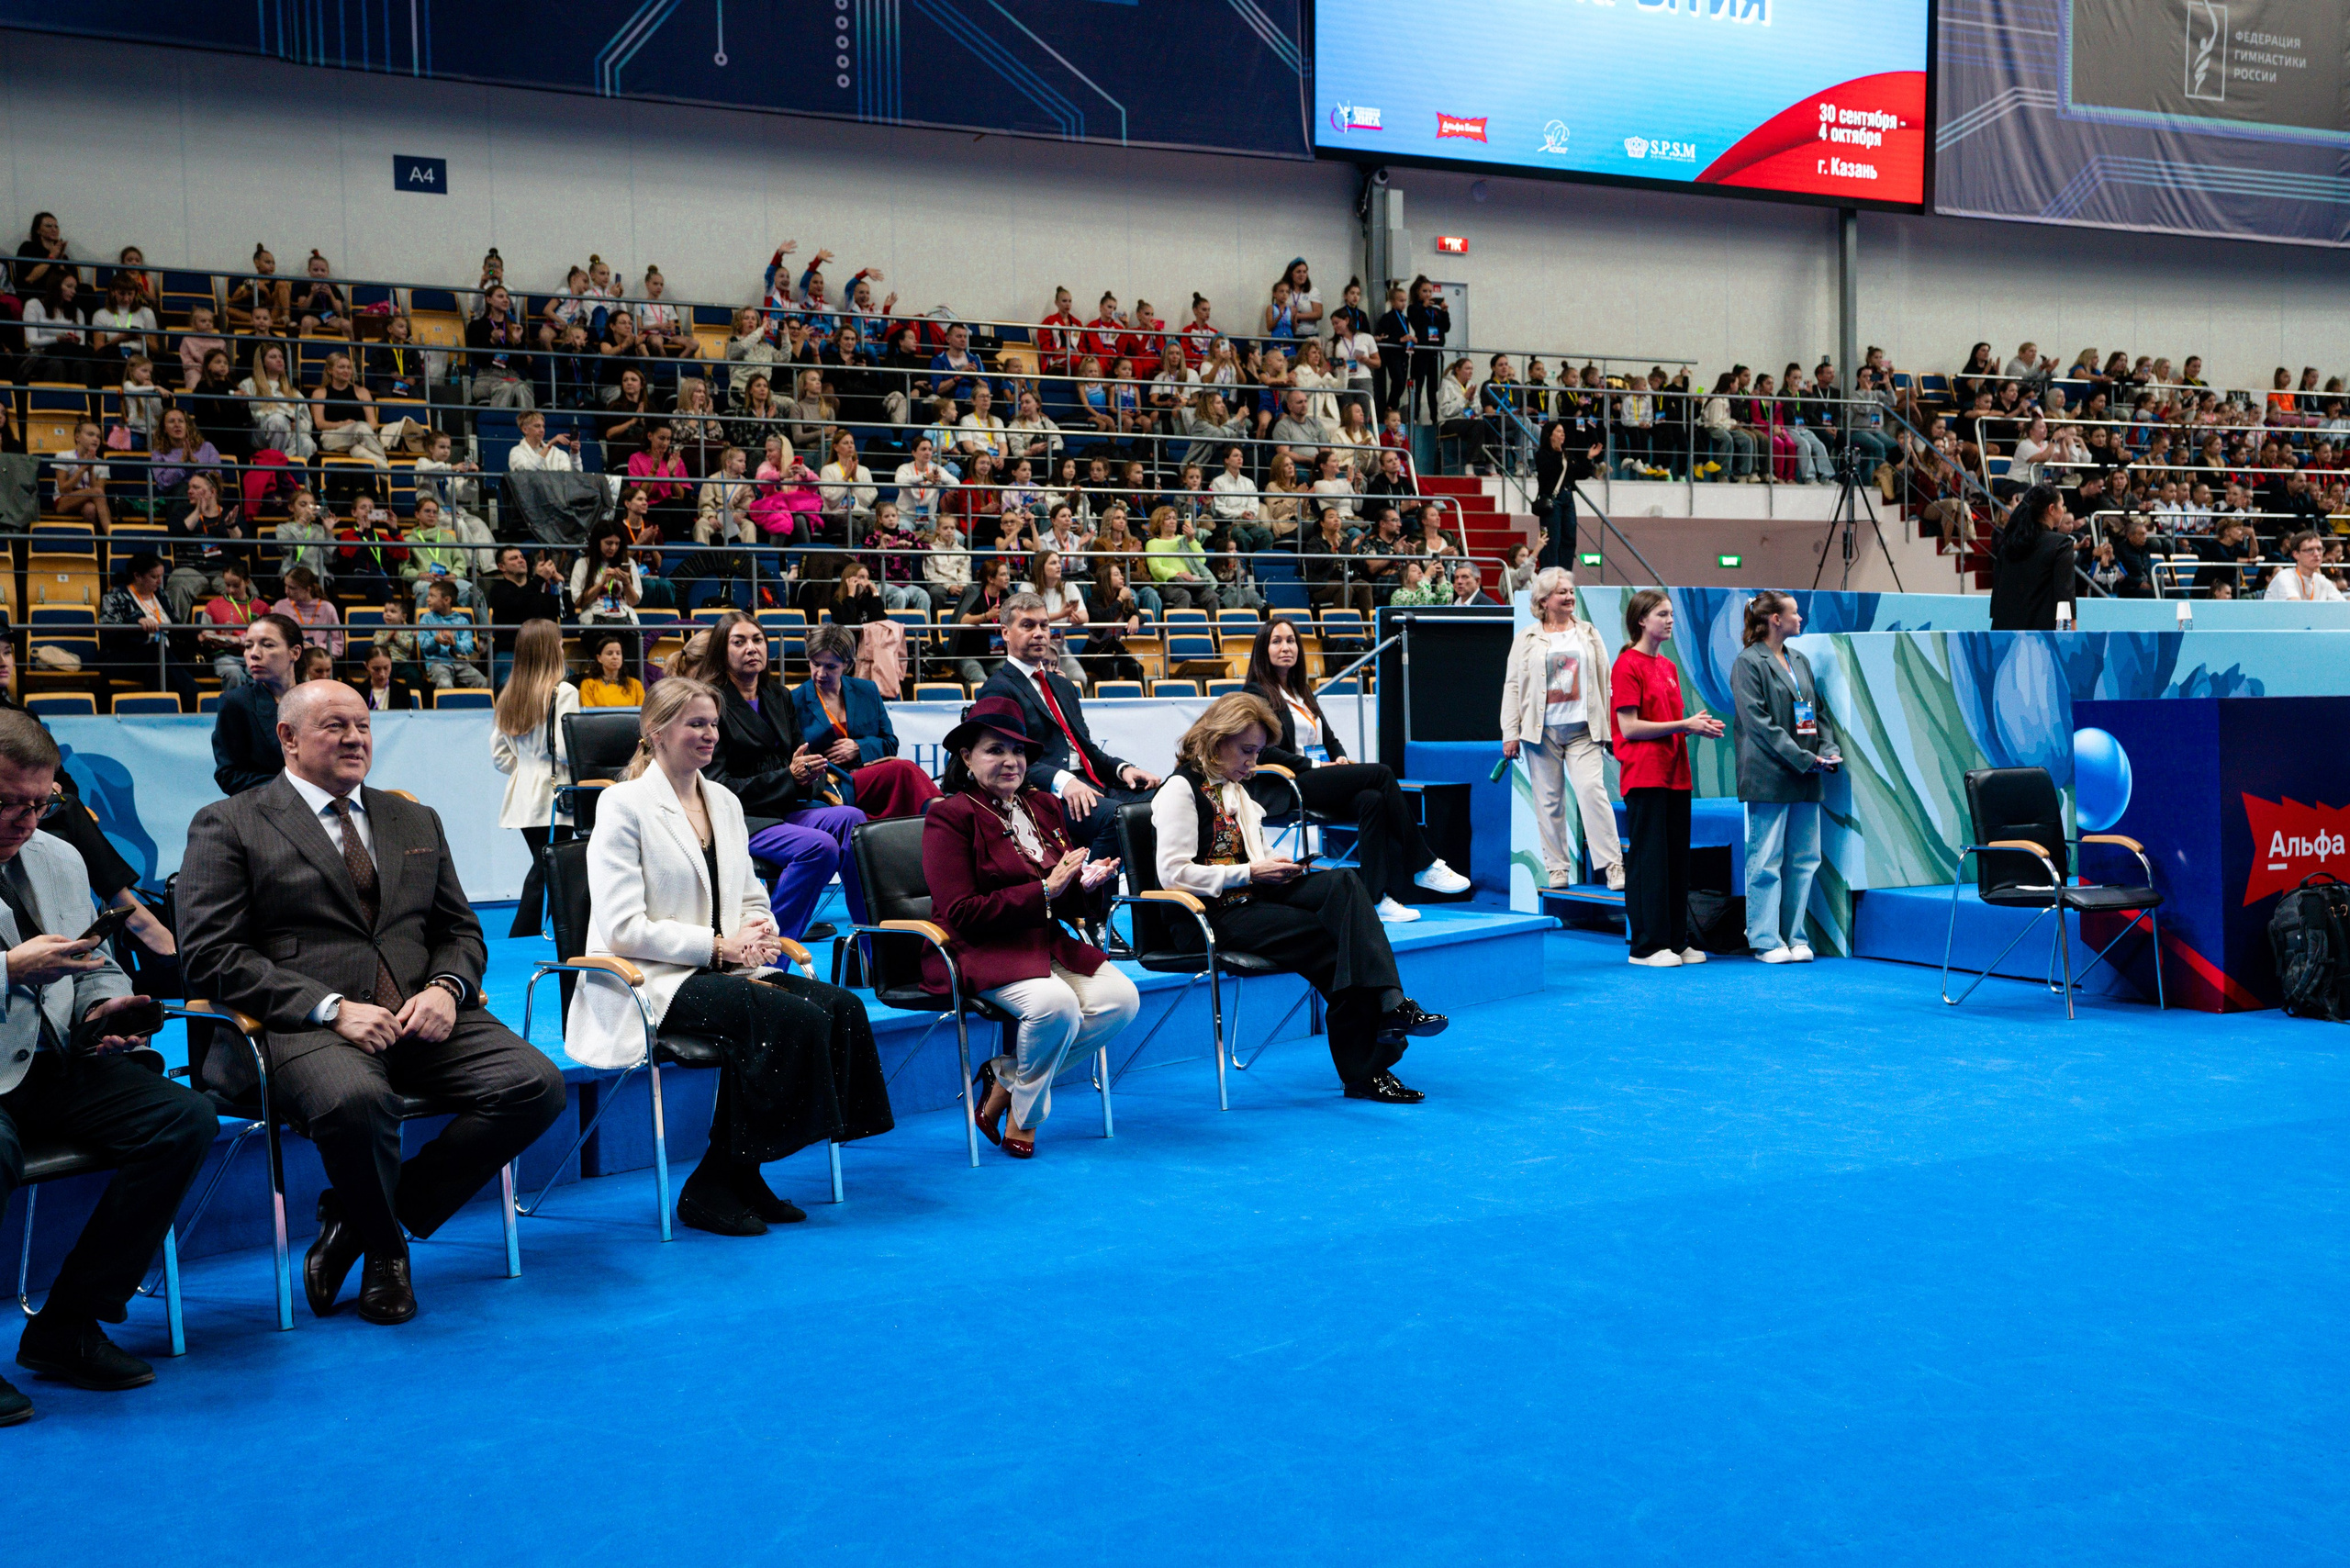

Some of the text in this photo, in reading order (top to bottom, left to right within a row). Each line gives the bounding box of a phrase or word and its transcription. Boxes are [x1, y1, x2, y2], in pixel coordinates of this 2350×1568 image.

[2235, 30, 2301, 50] ФЕДЕРАЦИЯ
[2233, 49, 2307, 69] ГИМНАСТИКИ
[2233, 67, 2277, 83] РОССИИ
[1818, 103, 1836, 123] 30
[1839, 109, 1897, 132] сентября
[1818, 122, 1882, 150] 4 октября
[409, 166, 434, 184] A4
[1818, 156, 1878, 180] г. Казань
[2268, 829, 2345, 863] Альфа
